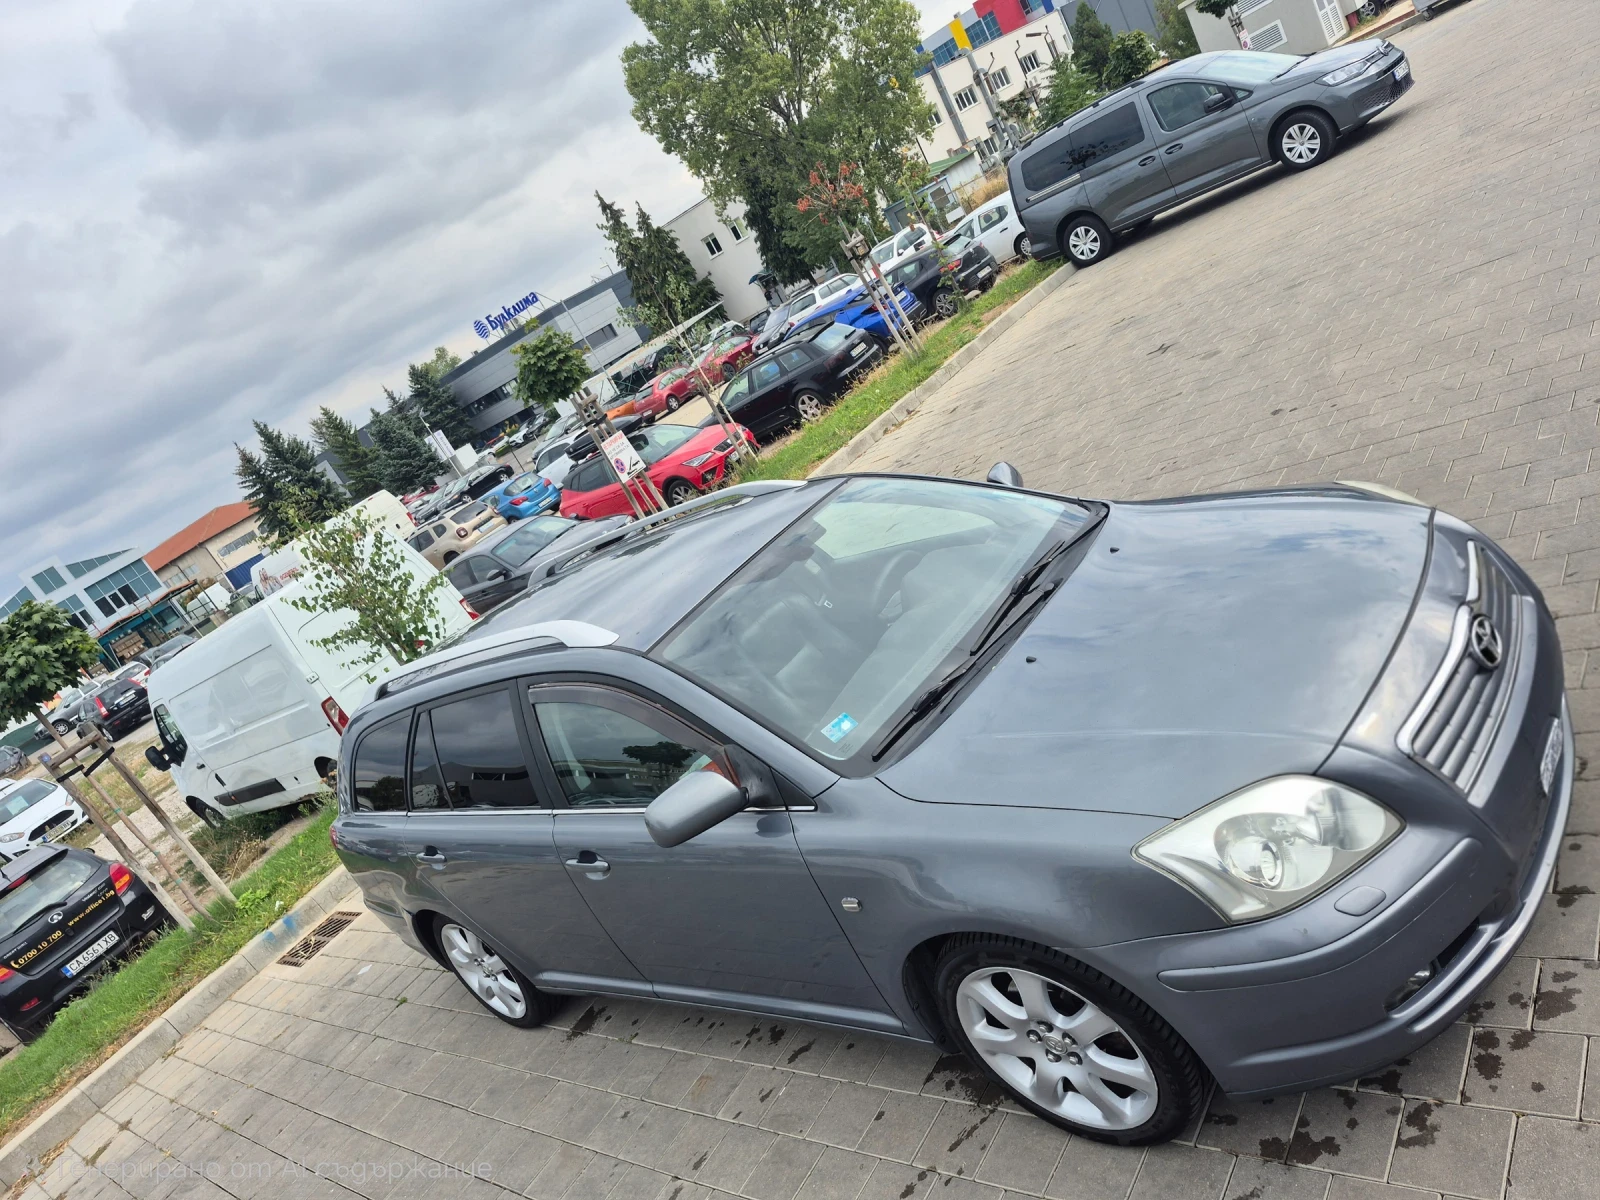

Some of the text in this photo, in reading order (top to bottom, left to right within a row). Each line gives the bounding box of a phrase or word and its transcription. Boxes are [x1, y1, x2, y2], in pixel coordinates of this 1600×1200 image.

[68, 890, 115, 927] www.office1.bg
[18, 930, 62, 965] 0700 10 700
[82, 944, 104, 963] 6561
